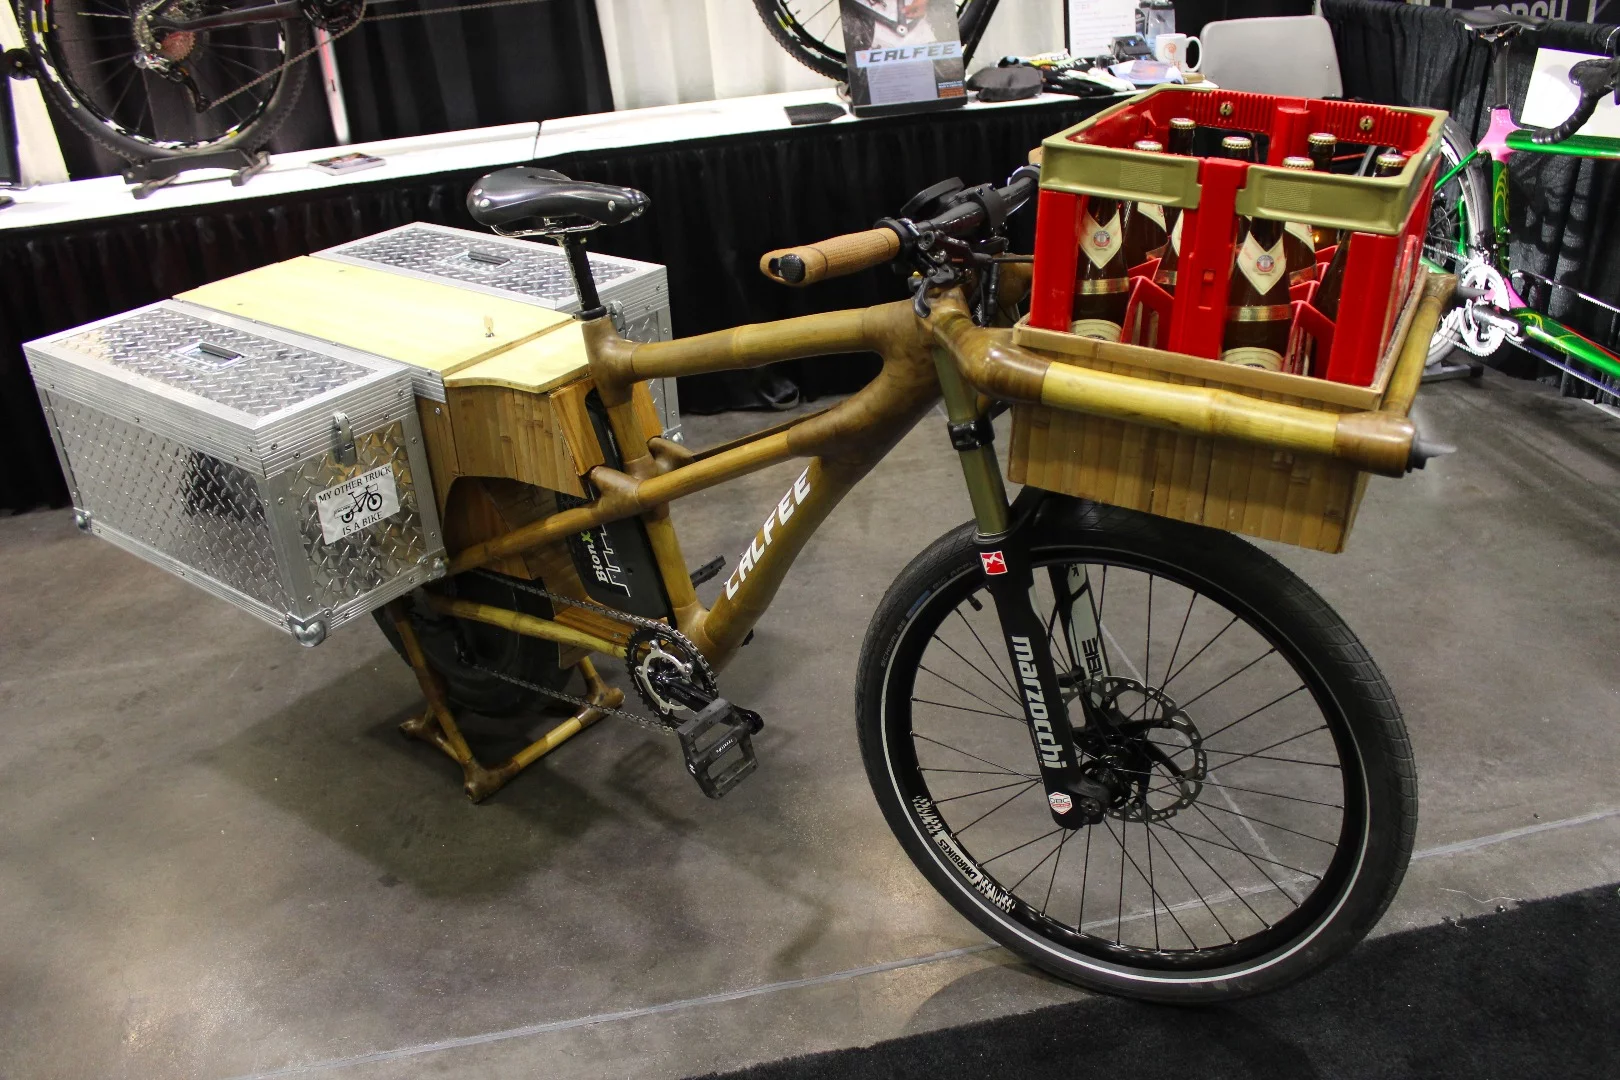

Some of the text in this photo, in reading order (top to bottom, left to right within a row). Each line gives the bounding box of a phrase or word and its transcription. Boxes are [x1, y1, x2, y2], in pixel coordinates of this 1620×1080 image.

[868, 43, 956, 62] CALFEE
[318, 465, 391, 503] MY OTHER TRUCK
[342, 511, 383, 535] IS A BIKE
[724, 465, 811, 600] CALFEE
[1011, 635, 1067, 769] marzocchi
